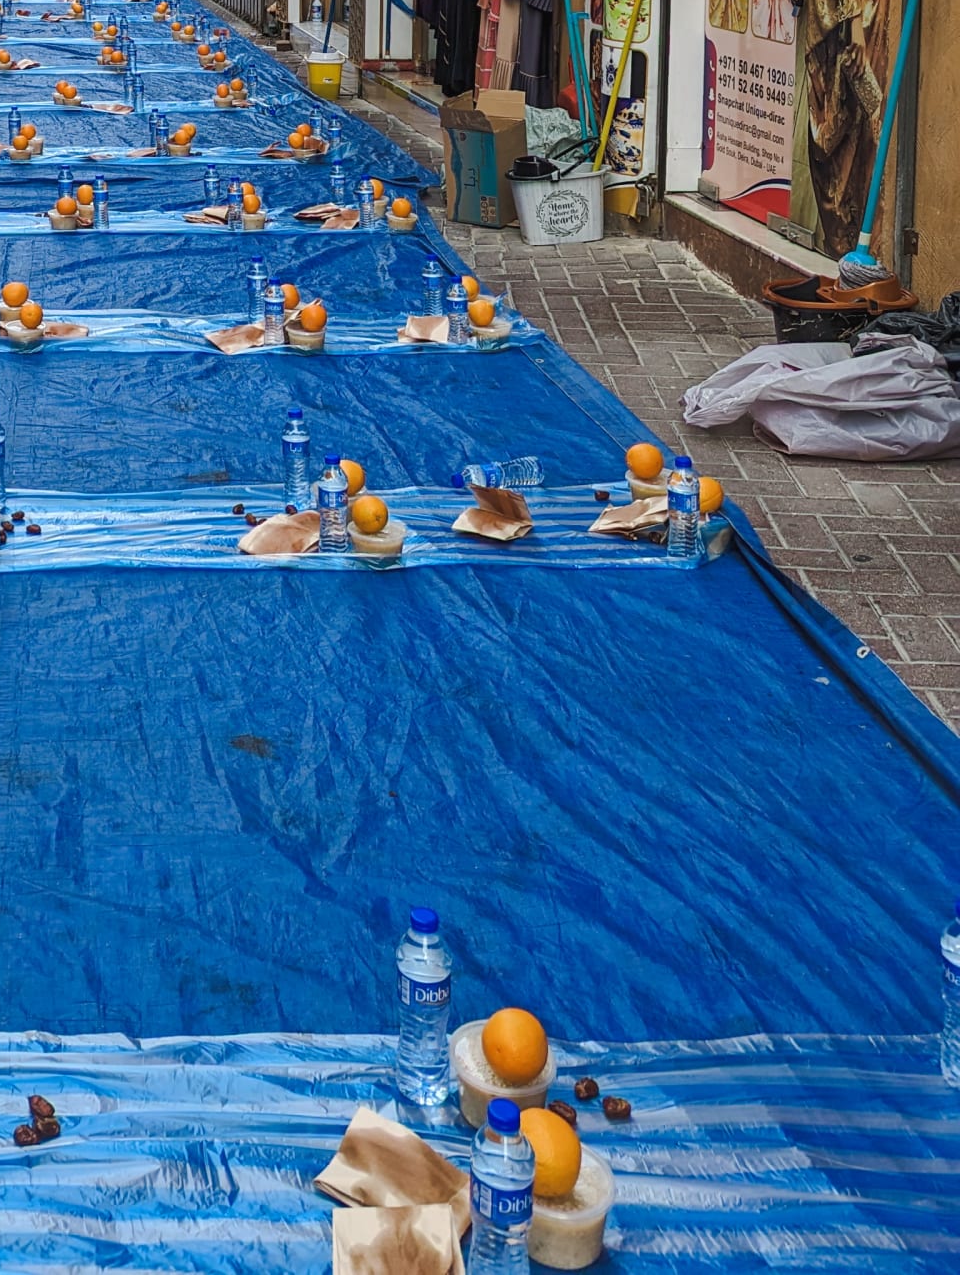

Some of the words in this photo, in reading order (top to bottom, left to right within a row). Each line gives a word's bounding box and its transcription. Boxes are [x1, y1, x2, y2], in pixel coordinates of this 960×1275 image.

[718, 55, 736, 72] +971
[739, 60, 748, 75] 50
[749, 63, 764, 80] 467
[767, 67, 787, 86] 1920
[718, 74, 736, 91] +971
[738, 78, 748, 94] 52
[749, 82, 764, 99] 456
[766, 86, 786, 106] 9449
[717, 93, 745, 113] Snapchat
[745, 102, 785, 126] Unique-dirac
[750, 156, 763, 170] Dubai
[766, 163, 777, 175] UAE
[761, 147, 773, 162] Shop
[781, 155, 785, 165] 4
[548, 202, 575, 212] Home
[549, 215, 574, 226] heart
